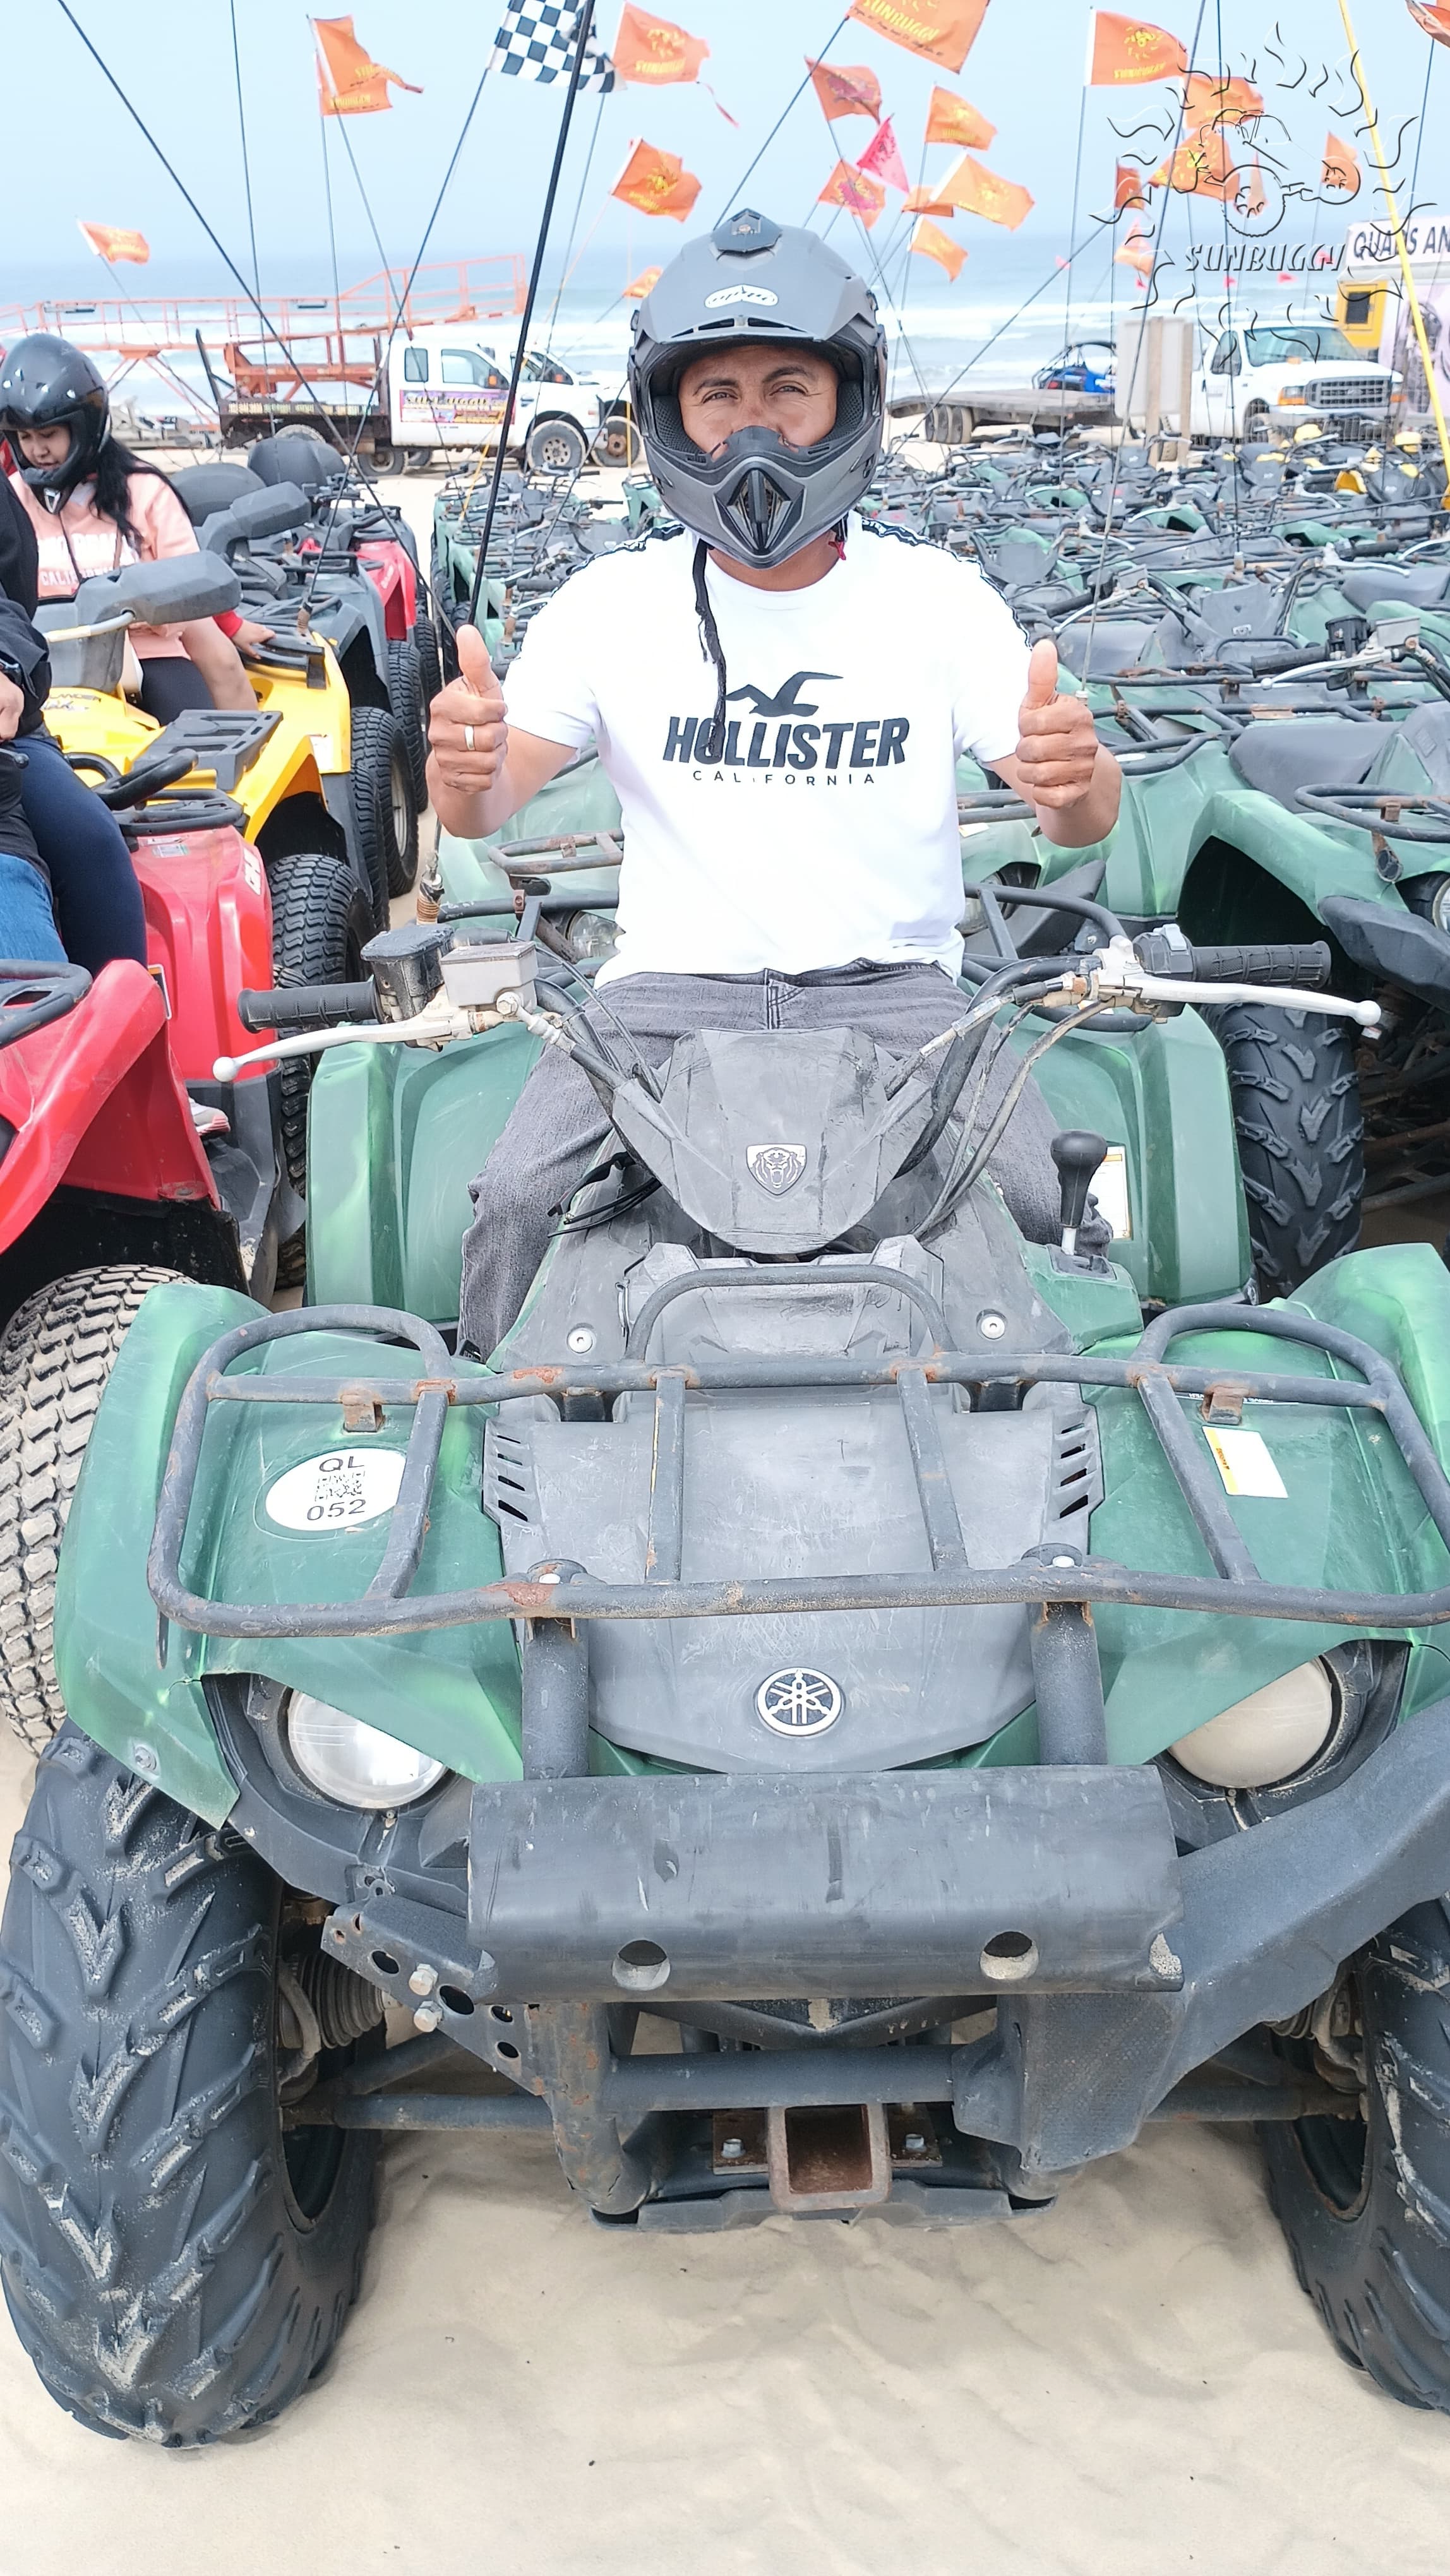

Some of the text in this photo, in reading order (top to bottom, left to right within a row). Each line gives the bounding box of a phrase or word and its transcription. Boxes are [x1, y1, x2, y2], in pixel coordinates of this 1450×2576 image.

[662, 716, 910, 770] HOLLISTER
[693, 770, 875, 786] CALIFORNIA
[319, 1456, 365, 1472] QL
[306, 1499, 366, 1521] 052
